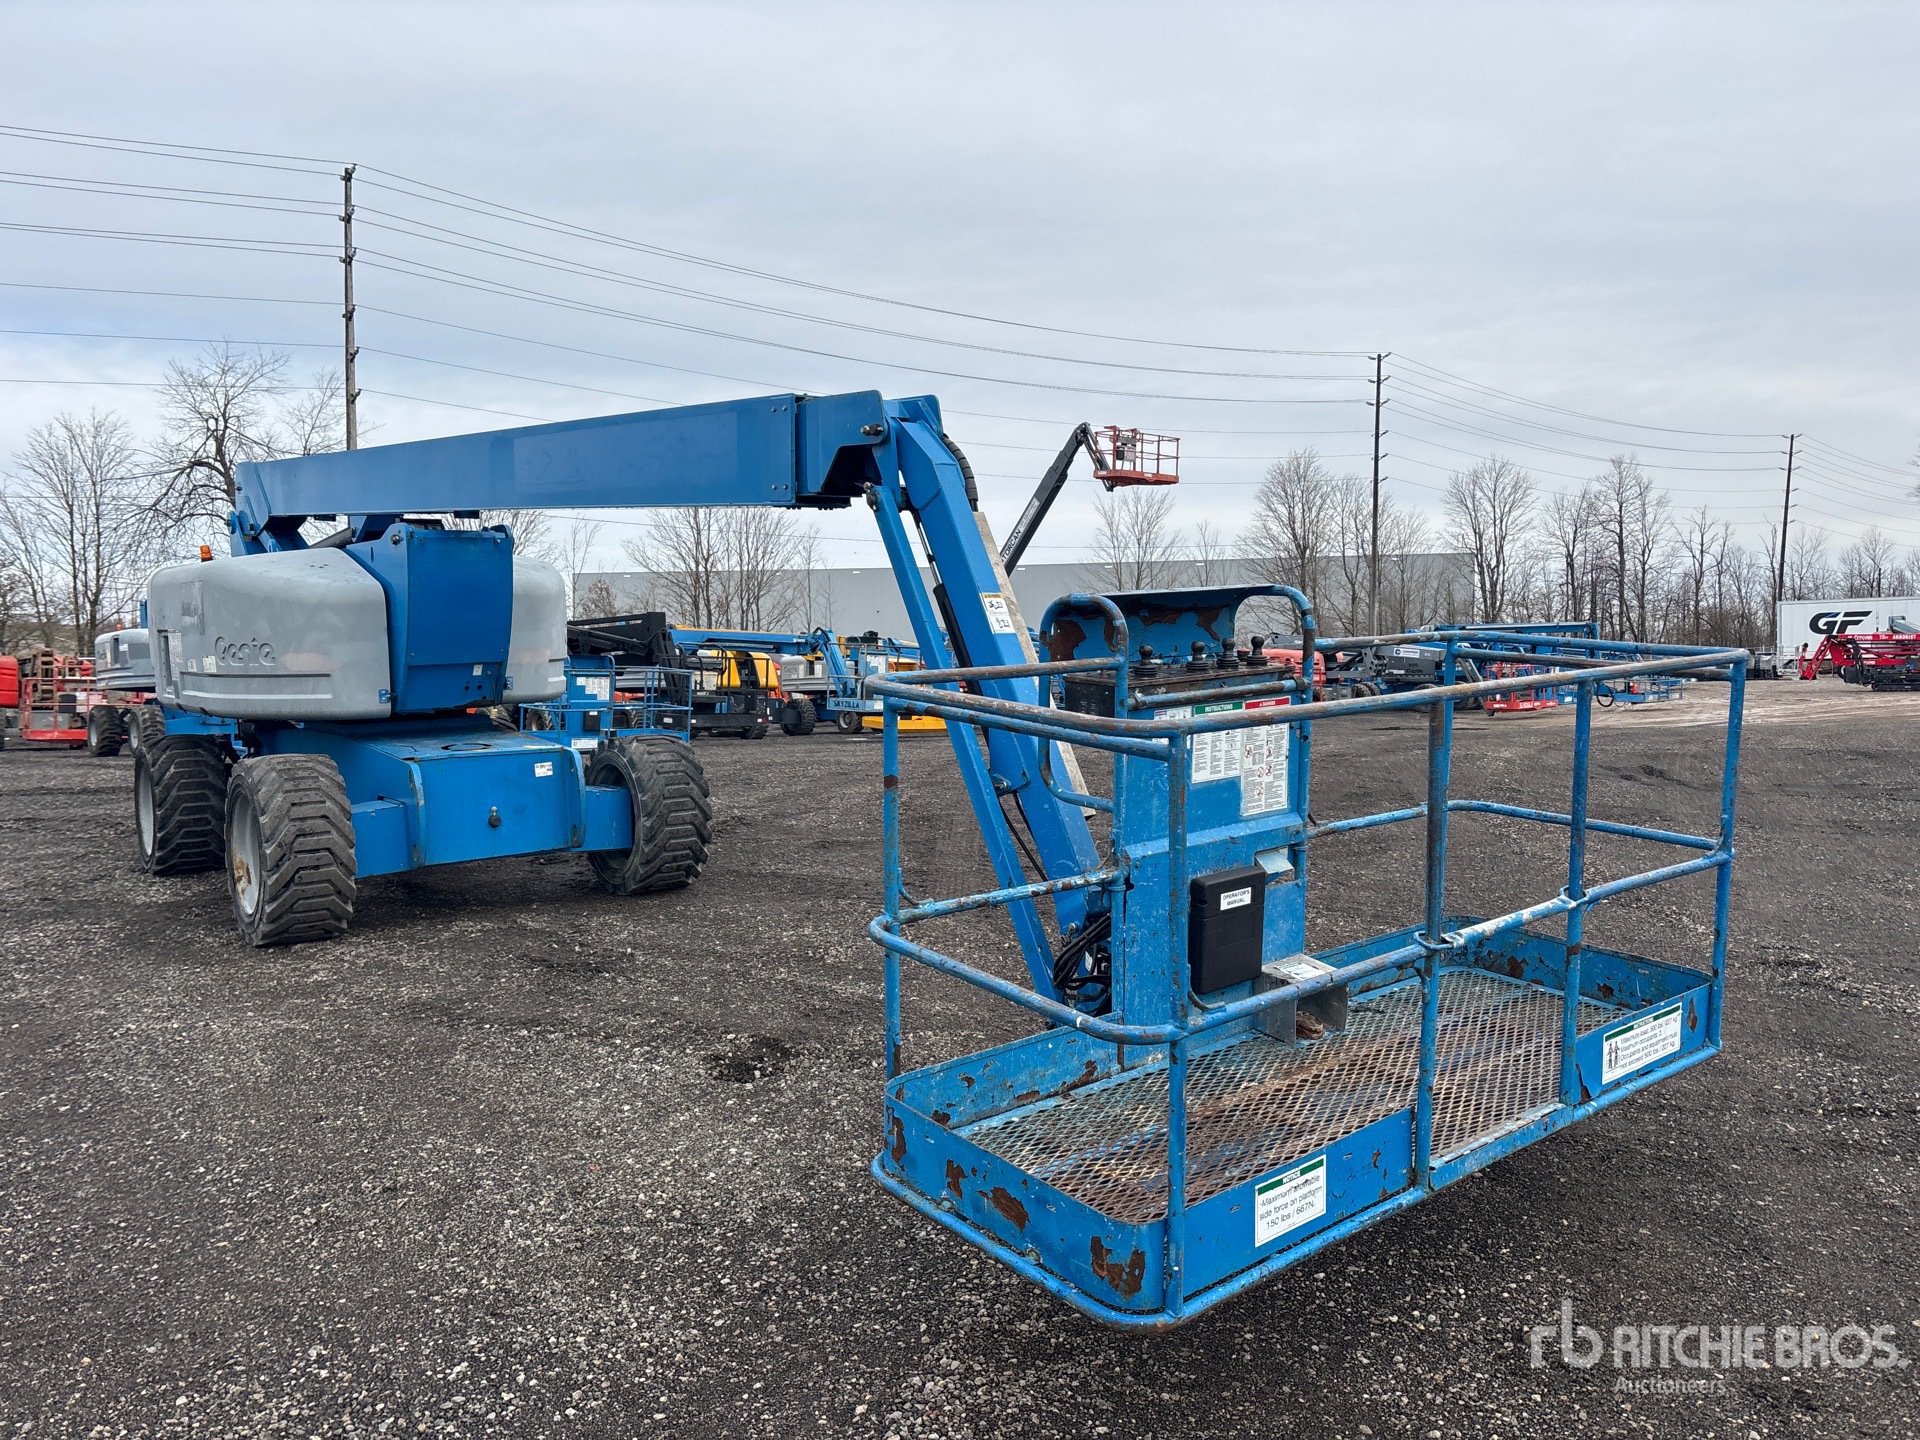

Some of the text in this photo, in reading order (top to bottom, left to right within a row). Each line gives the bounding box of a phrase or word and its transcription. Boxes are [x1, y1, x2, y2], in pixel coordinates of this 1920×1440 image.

[1809, 611, 1872, 635] GF
[833, 700, 860, 709] SKYZLA
[1204, 703, 1233, 712] INSTRUCTIONS
[1226, 898, 1245, 906] MANUAL
[1259, 1185, 1323, 1221] side force on platform
[1261, 1186, 1293, 1207] Maximum
[1266, 1217, 1279, 1229] 150
[1281, 1211, 1291, 1222] lbs
